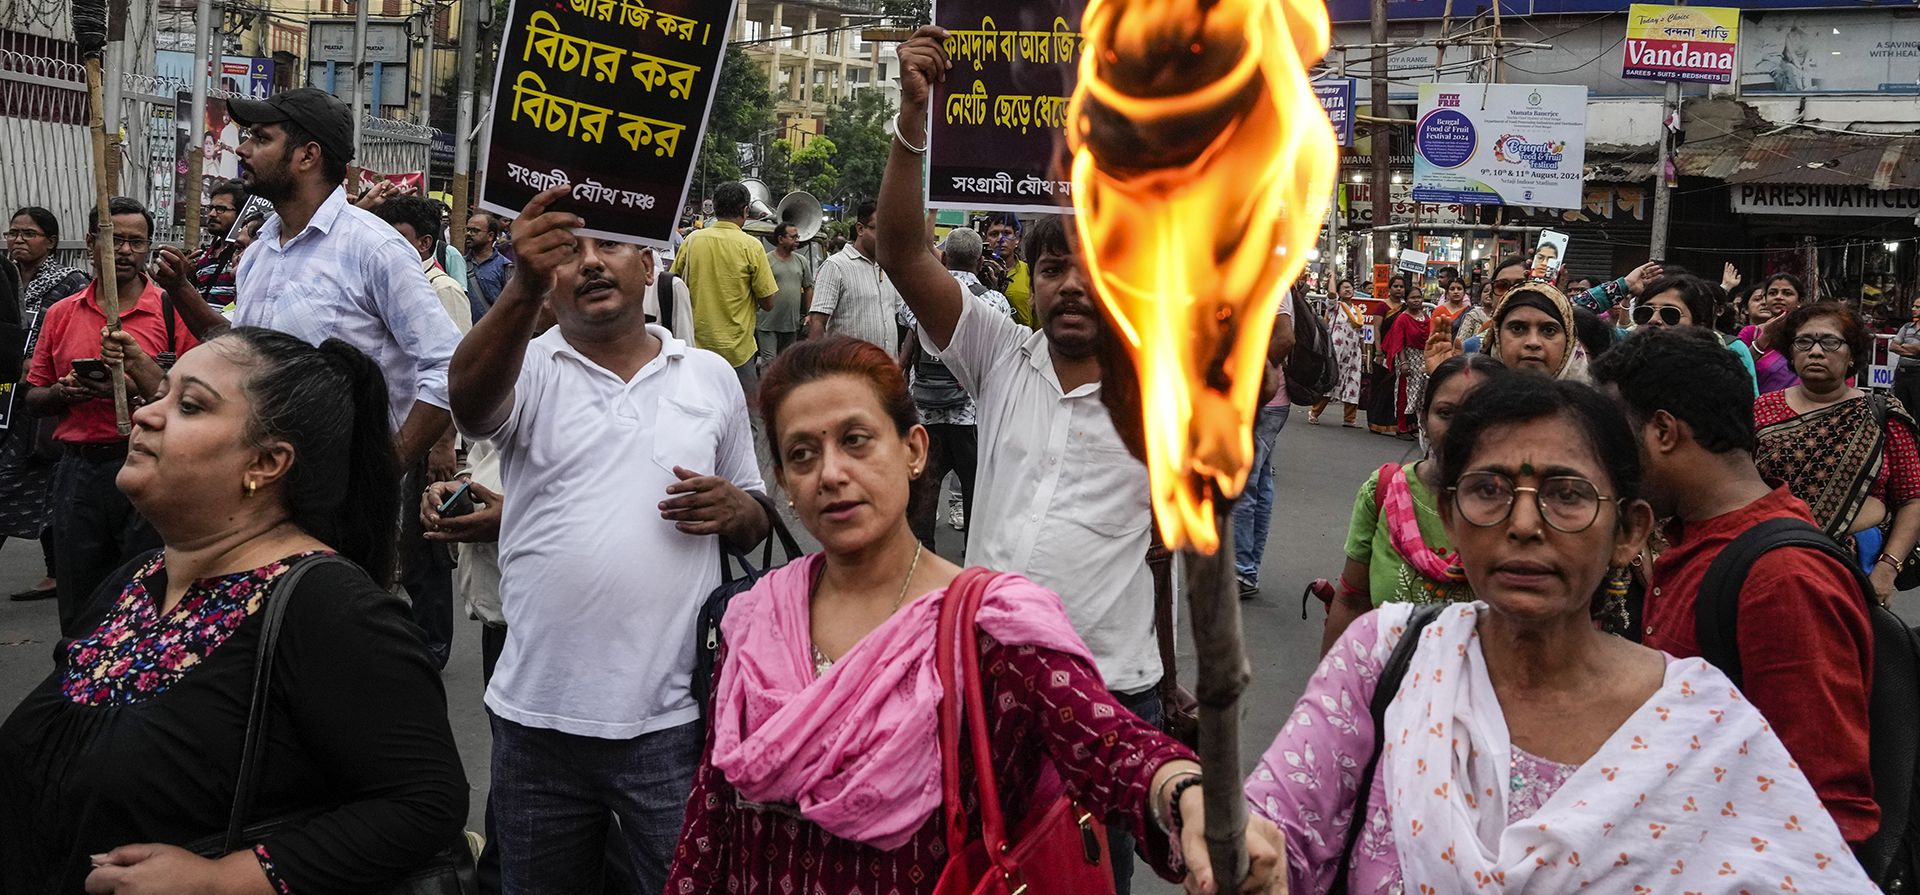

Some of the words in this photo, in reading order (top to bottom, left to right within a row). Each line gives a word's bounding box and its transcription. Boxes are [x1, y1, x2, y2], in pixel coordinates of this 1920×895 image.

[570, 0, 617, 23] আর
[619, 0, 653, 31] জি
[656, 11, 698, 41] কর
[1638, 15, 1665, 25] Today's
[1667, 13, 1690, 23] Choice
[943, 15, 998, 71] কামদুনি
[1000, 31, 1018, 62] বা
[1019, 31, 1051, 64] আর
[1053, 16, 1076, 64] জি
[1664, 27, 1696, 37] বন্দনা
[1701, 26, 1729, 40] শাড়ি
[523, 10, 627, 84] বিচার
[631, 51, 701, 100] কর
[1628, 40, 1732, 70] Vandana
[511, 70, 614, 144] বিচার
[617, 111, 686, 158] কর
[946, 79, 988, 126] নেংটি
[1437, 118, 1460, 126] Bengal
[1507, 138, 1548, 154] Bengal
[1530, 160, 1558, 169] Festival
[1531, 171, 1559, 180] August,
[1560, 172, 1580, 180] 2024
[572, 178, 619, 206] যৌথ
[622, 190, 656, 210] মঞ্চ
[952, 172, 1014, 194] সংগ্রামী
[1017, 174, 1056, 196] যৌথ
[1741, 184, 1820, 207] PARESH
[1824, 185, 1878, 208] NATH
[1873, 368, 1894, 385] KOL
